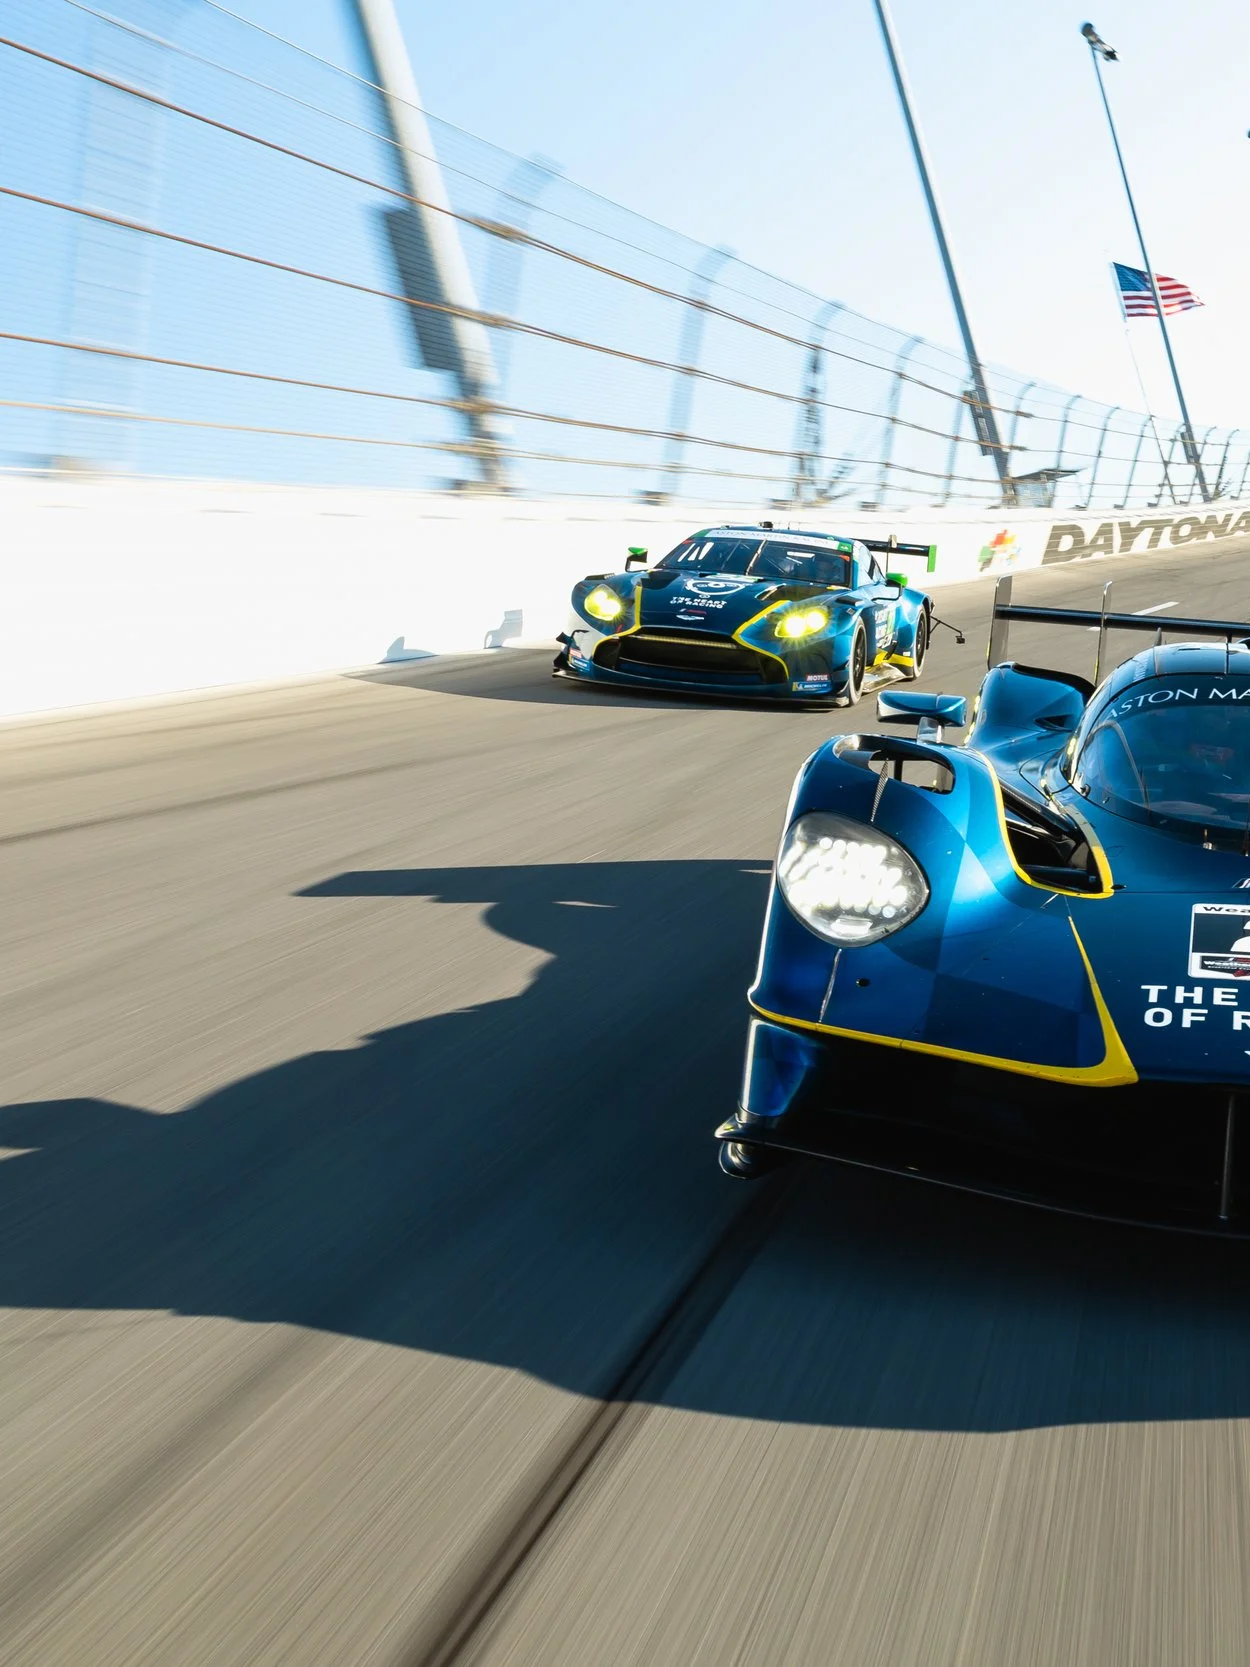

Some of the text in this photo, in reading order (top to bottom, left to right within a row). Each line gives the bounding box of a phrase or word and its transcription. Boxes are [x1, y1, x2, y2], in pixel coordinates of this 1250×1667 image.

[685, 601, 724, 609] RACING
[694, 598, 727, 606] HEART
[1106, 688, 1198, 718] ASTON
[1140, 985, 1239, 1007] THE
[1143, 1007, 1209, 1029] OF
